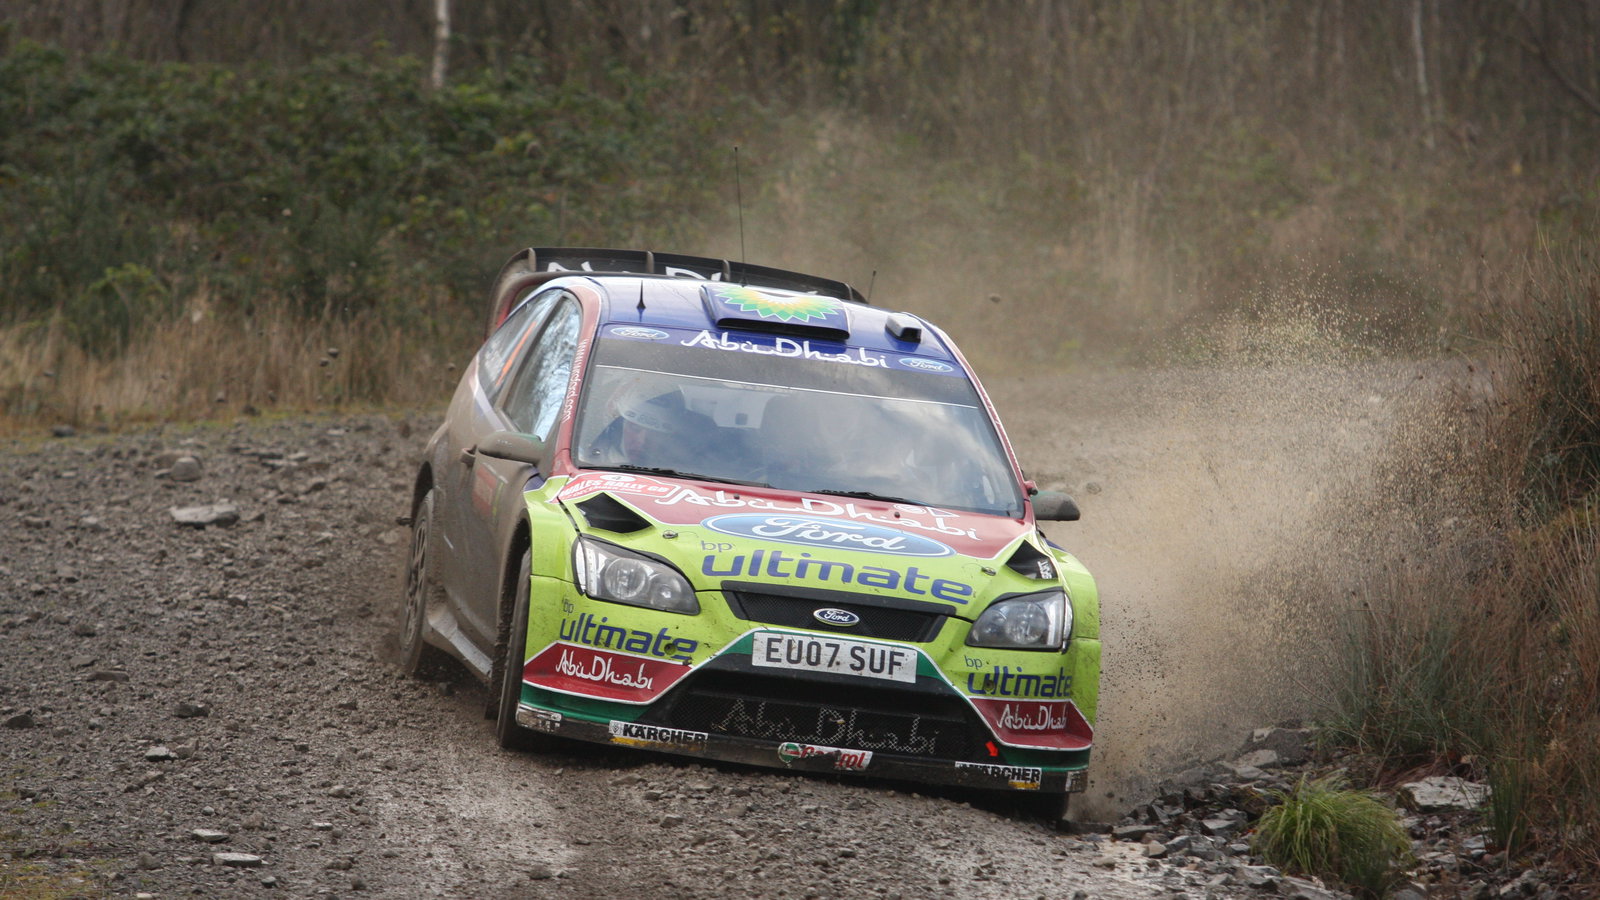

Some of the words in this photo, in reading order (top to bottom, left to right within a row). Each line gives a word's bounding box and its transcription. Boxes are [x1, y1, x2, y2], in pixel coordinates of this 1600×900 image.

[620, 328, 660, 339] Ford
[560, 480, 604, 496] WALES
[604, 481, 646, 490] RALLY
[751, 514, 907, 551] Ford
[700, 540, 732, 553] bp
[701, 549, 973, 605] ultimate
[822, 609, 850, 622] Ford
[559, 612, 699, 660] ultimate
[765, 637, 840, 668] EU07
[849, 646, 905, 676] SUF
[964, 655, 983, 670] bp
